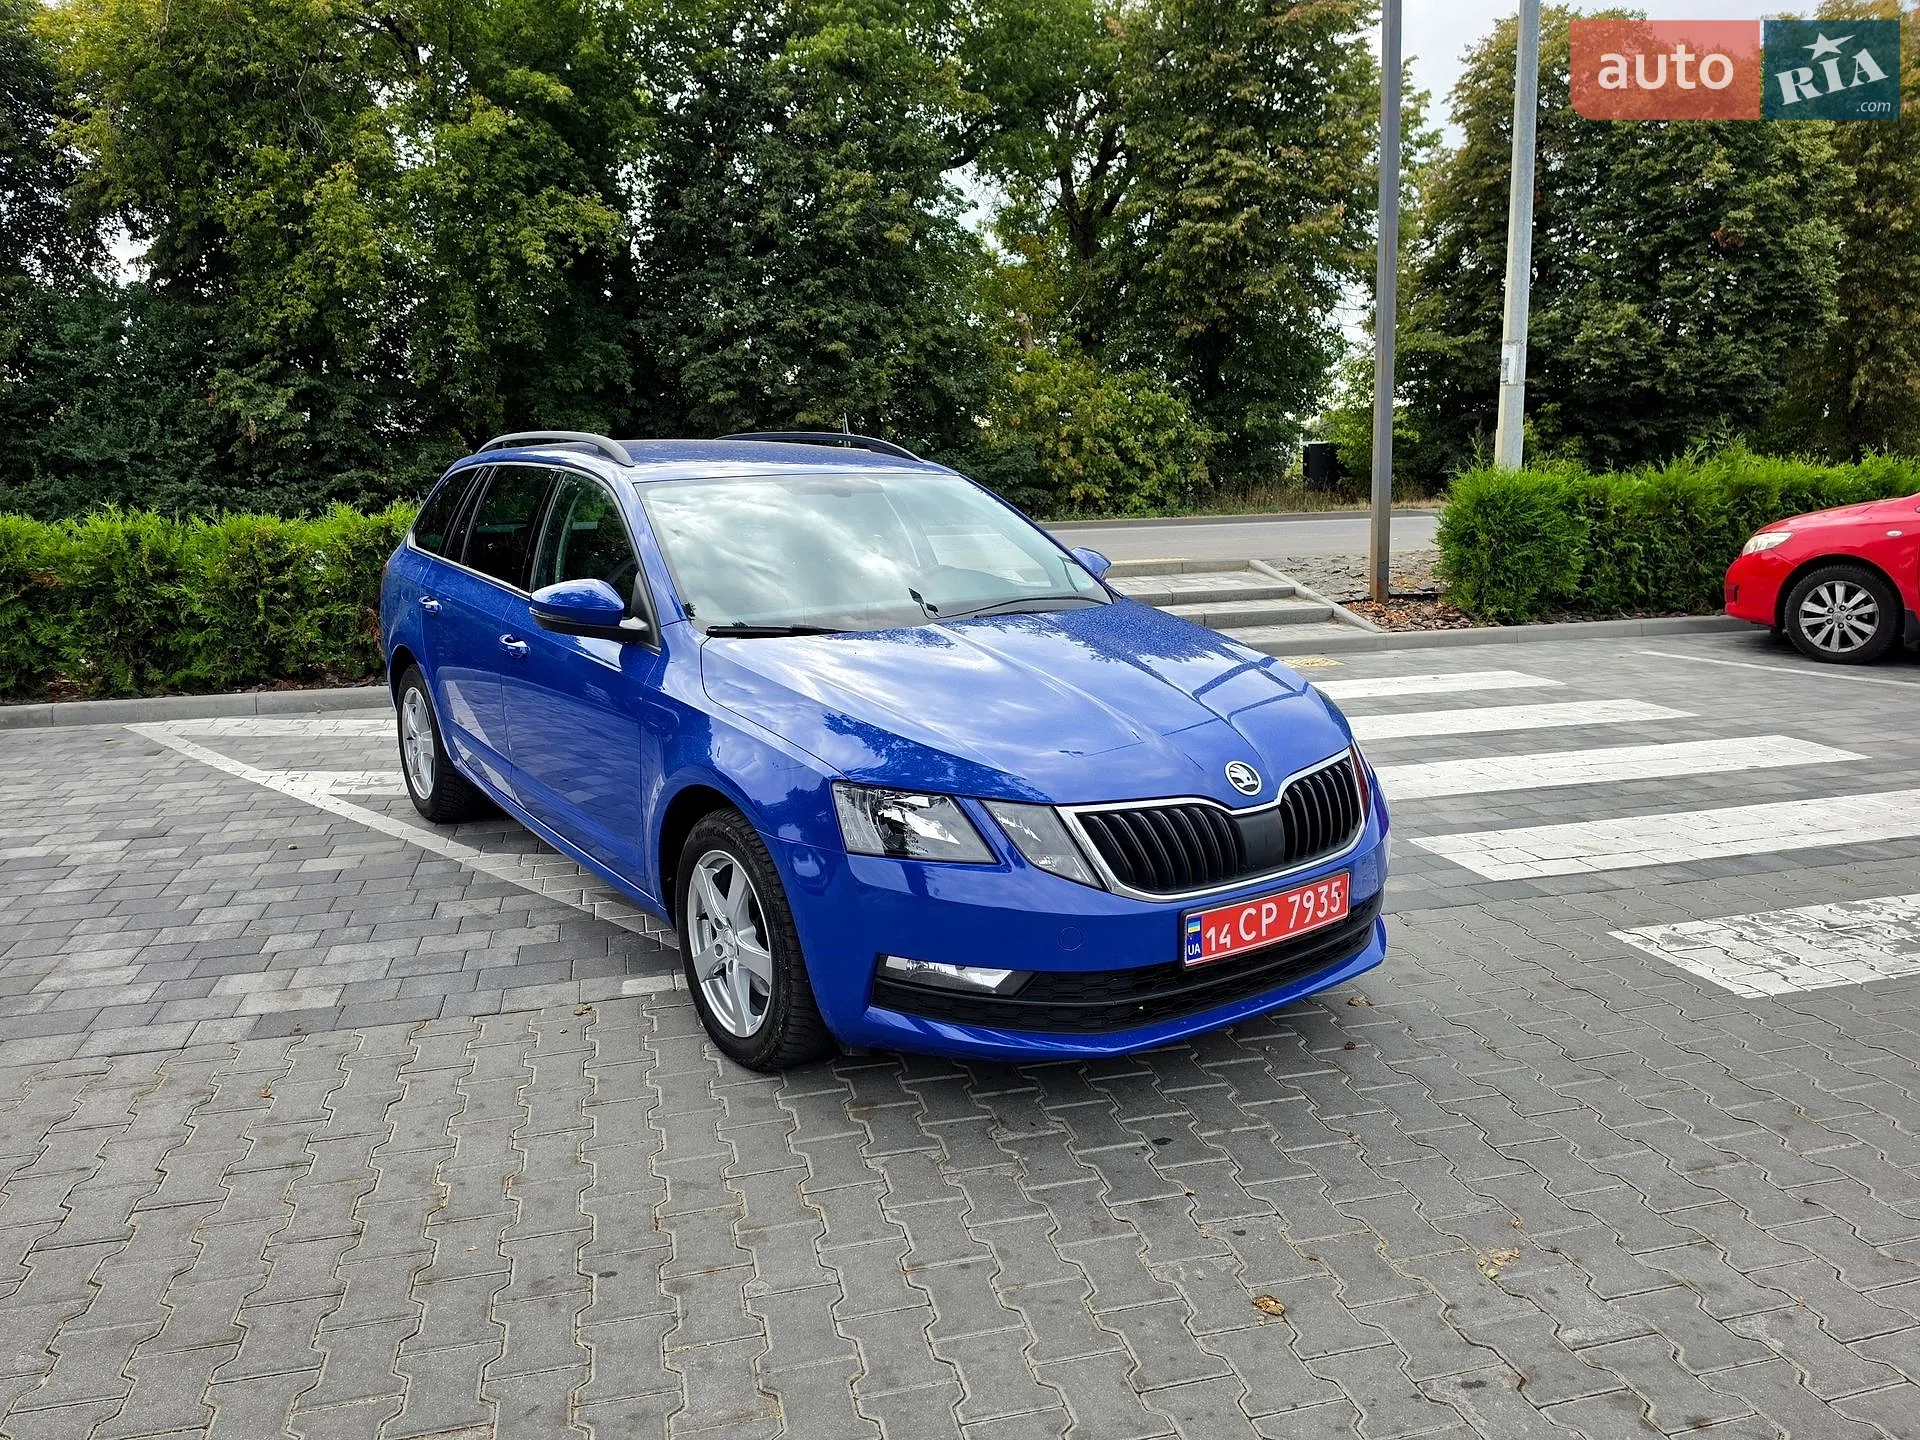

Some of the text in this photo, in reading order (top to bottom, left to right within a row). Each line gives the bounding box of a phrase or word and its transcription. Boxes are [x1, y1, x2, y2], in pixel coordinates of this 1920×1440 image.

[1205, 880, 1342, 952] 14 CP 7935
[1187, 943, 1201, 956] UA
